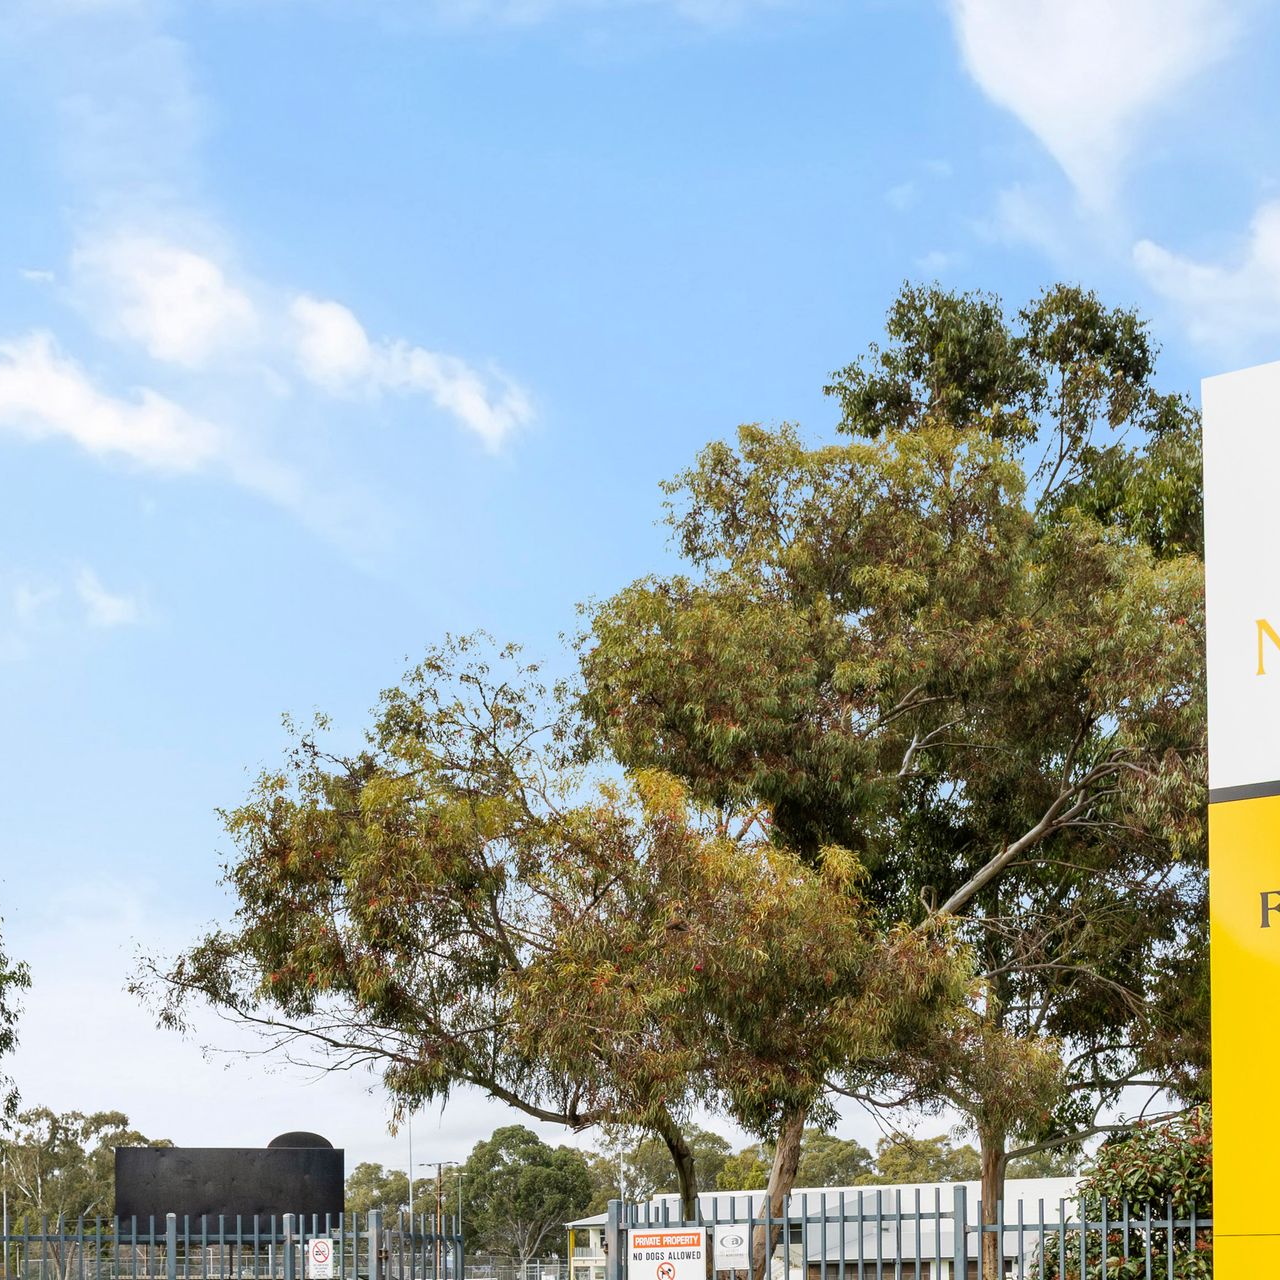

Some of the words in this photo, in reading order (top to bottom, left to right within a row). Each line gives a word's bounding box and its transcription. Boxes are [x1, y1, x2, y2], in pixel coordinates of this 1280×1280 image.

[635, 1236, 661, 1246] PRIVATE
[663, 1235, 699, 1245] PROPERTY
[633, 1252, 643, 1261] NO
[646, 1251, 665, 1261] DOGS
[668, 1250, 701, 1260] ALLOWED
